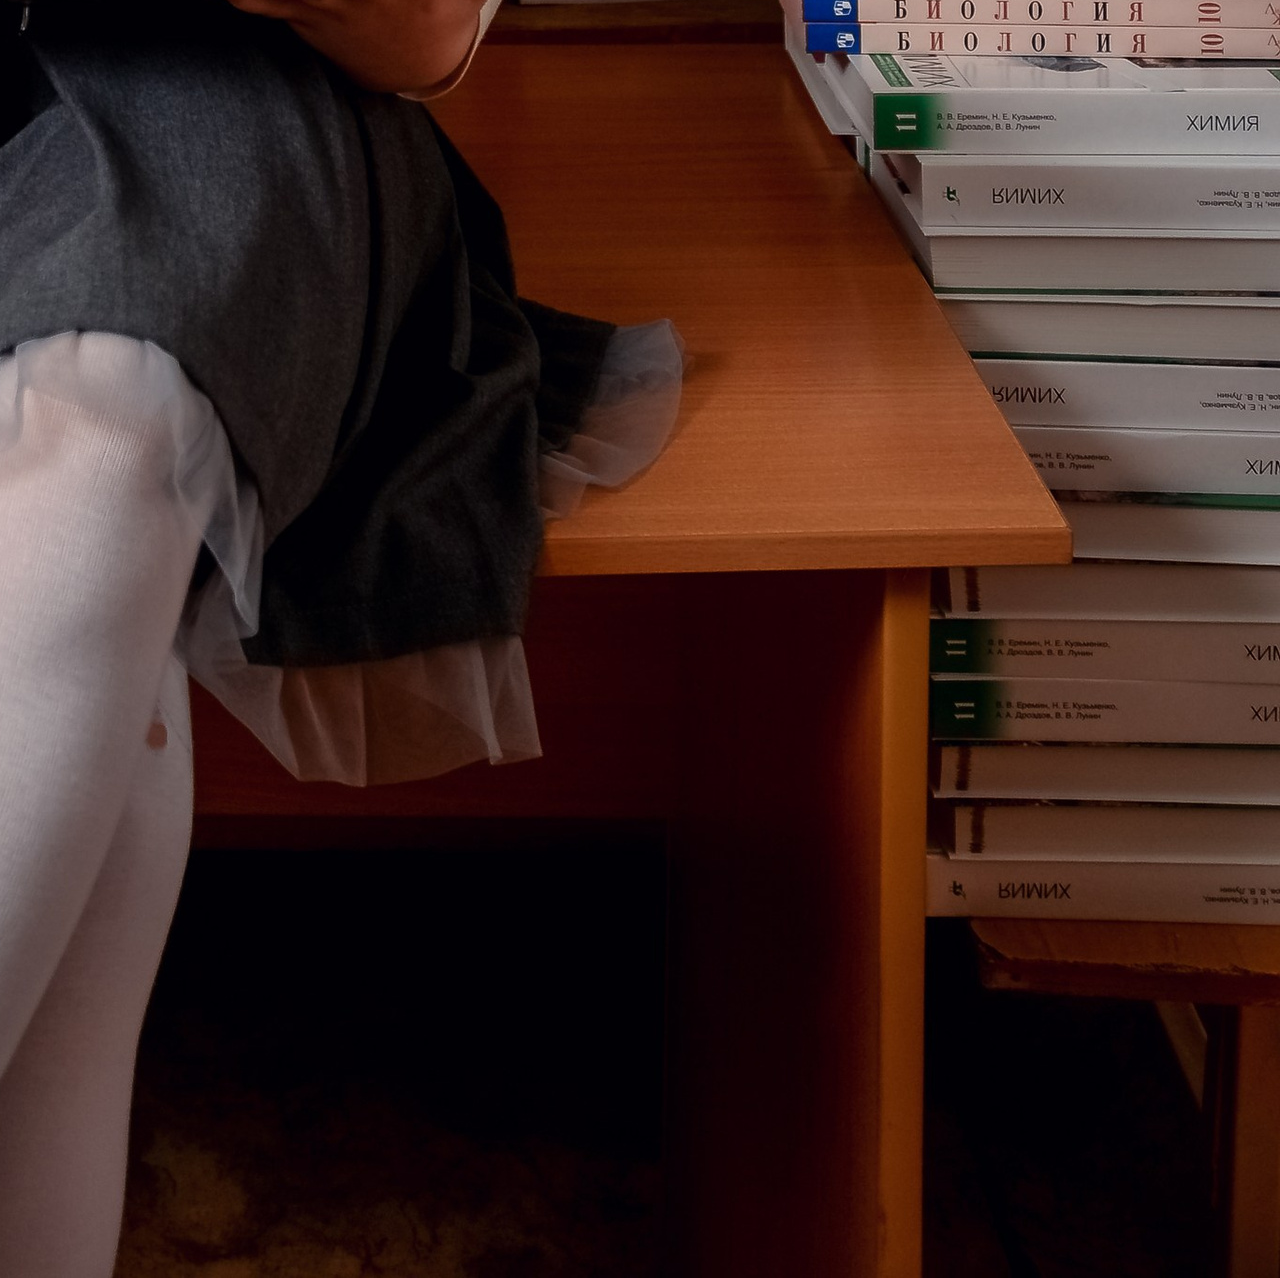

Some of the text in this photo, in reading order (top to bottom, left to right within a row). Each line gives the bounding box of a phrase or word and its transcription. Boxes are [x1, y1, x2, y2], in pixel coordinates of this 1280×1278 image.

[894, 0, 1221, 23] БИОЛОГИЯ 10
[897, 31, 1224, 55] БИОЛОГИЯ 10
[901, 54, 961, 88] ХИМ
[895, 113, 917, 131] 11
[937, 113, 1057, 122] В. В. Еремин, Н. Е. Кузьменко,
[1187, 115, 1259, 132] ХИМИЯ
[956, 123, 993, 132] Дроздов,
[995, 123, 1003, 131] В.
[1006, 123, 1013, 131] В.
[1015, 123, 1041, 132] Лунин
[992, 187, 1065, 205] ХИМИЯ
[1213, 190, 1239, 198] Лунин
[1197, 200, 1242, 208] Кузьменко,
[992, 386, 1065, 404] ХИМИЯ
[998, 882, 1071, 899] ХИМИЯ
